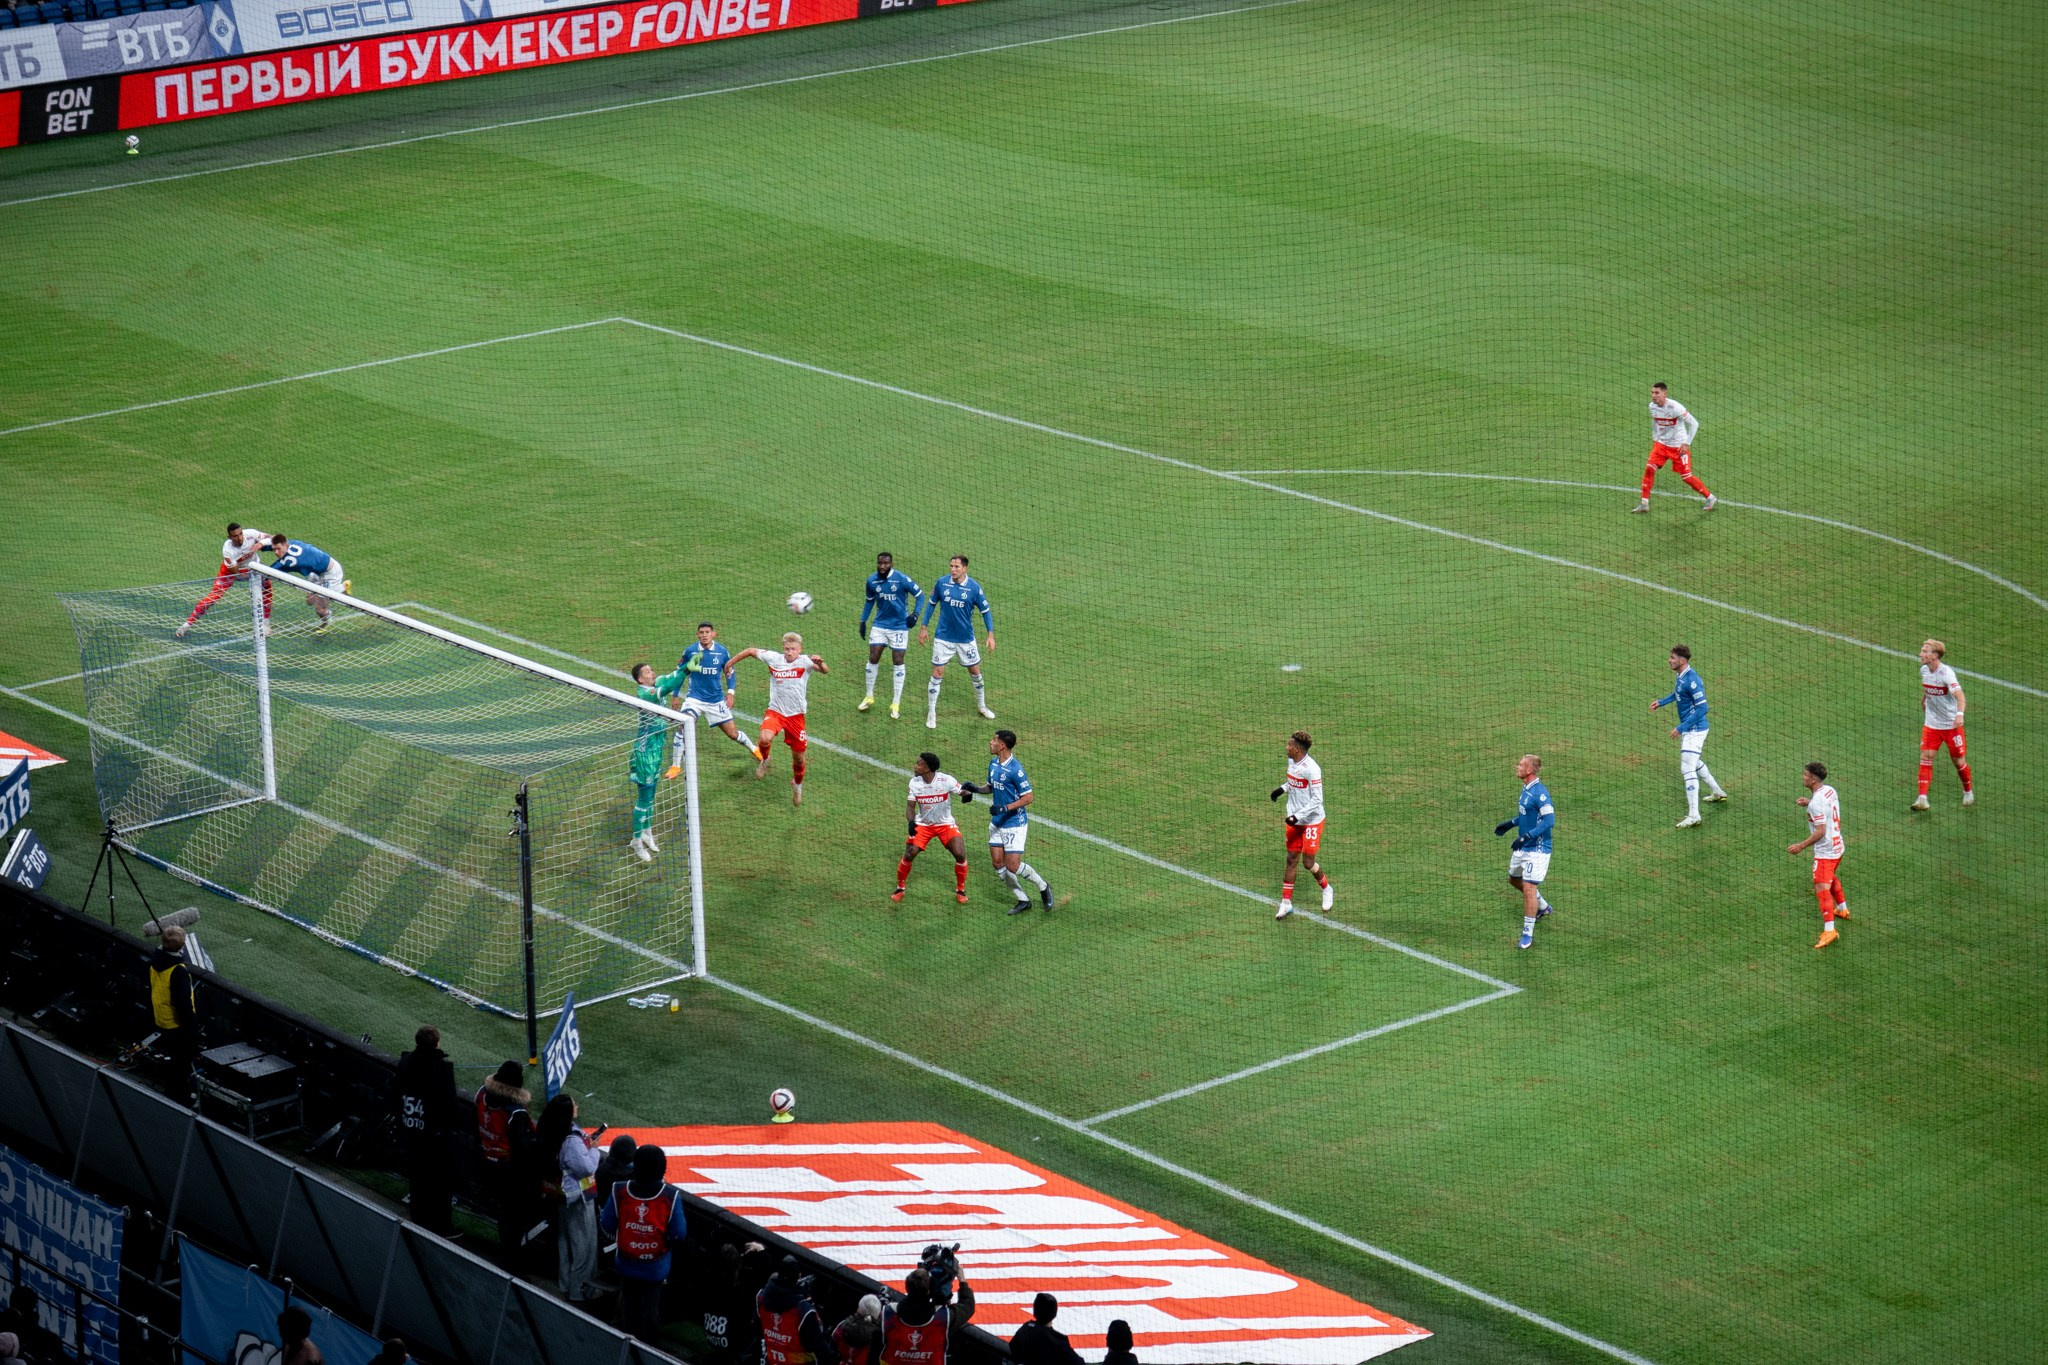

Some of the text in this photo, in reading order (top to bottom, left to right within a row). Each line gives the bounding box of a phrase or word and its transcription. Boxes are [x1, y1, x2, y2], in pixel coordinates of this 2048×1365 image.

[276, 0, 413, 38] BOSCO
[116, 21, 191, 65] ВТБ
[0, 42, 41, 81] ТБ
[155, 0, 791, 119] ПЕРВЫЙ БУКМЕКЕР FONBET
[45, 86, 92, 112] FON
[47, 109, 94, 135] BET
[280, 544, 303, 567] 50
[950, 599, 965, 608] ВТБ
[702, 667, 717, 675] ВТБ
[1953, 735, 1963, 747] 18
[1305, 827, 1318, 840] 83
[29, 843, 48, 874] ВТБ
[625, 1222, 659, 1233] FONBE
[629, 1241, 659, 1250] ФОТО
[894, 1350, 933, 1360] FONBET
